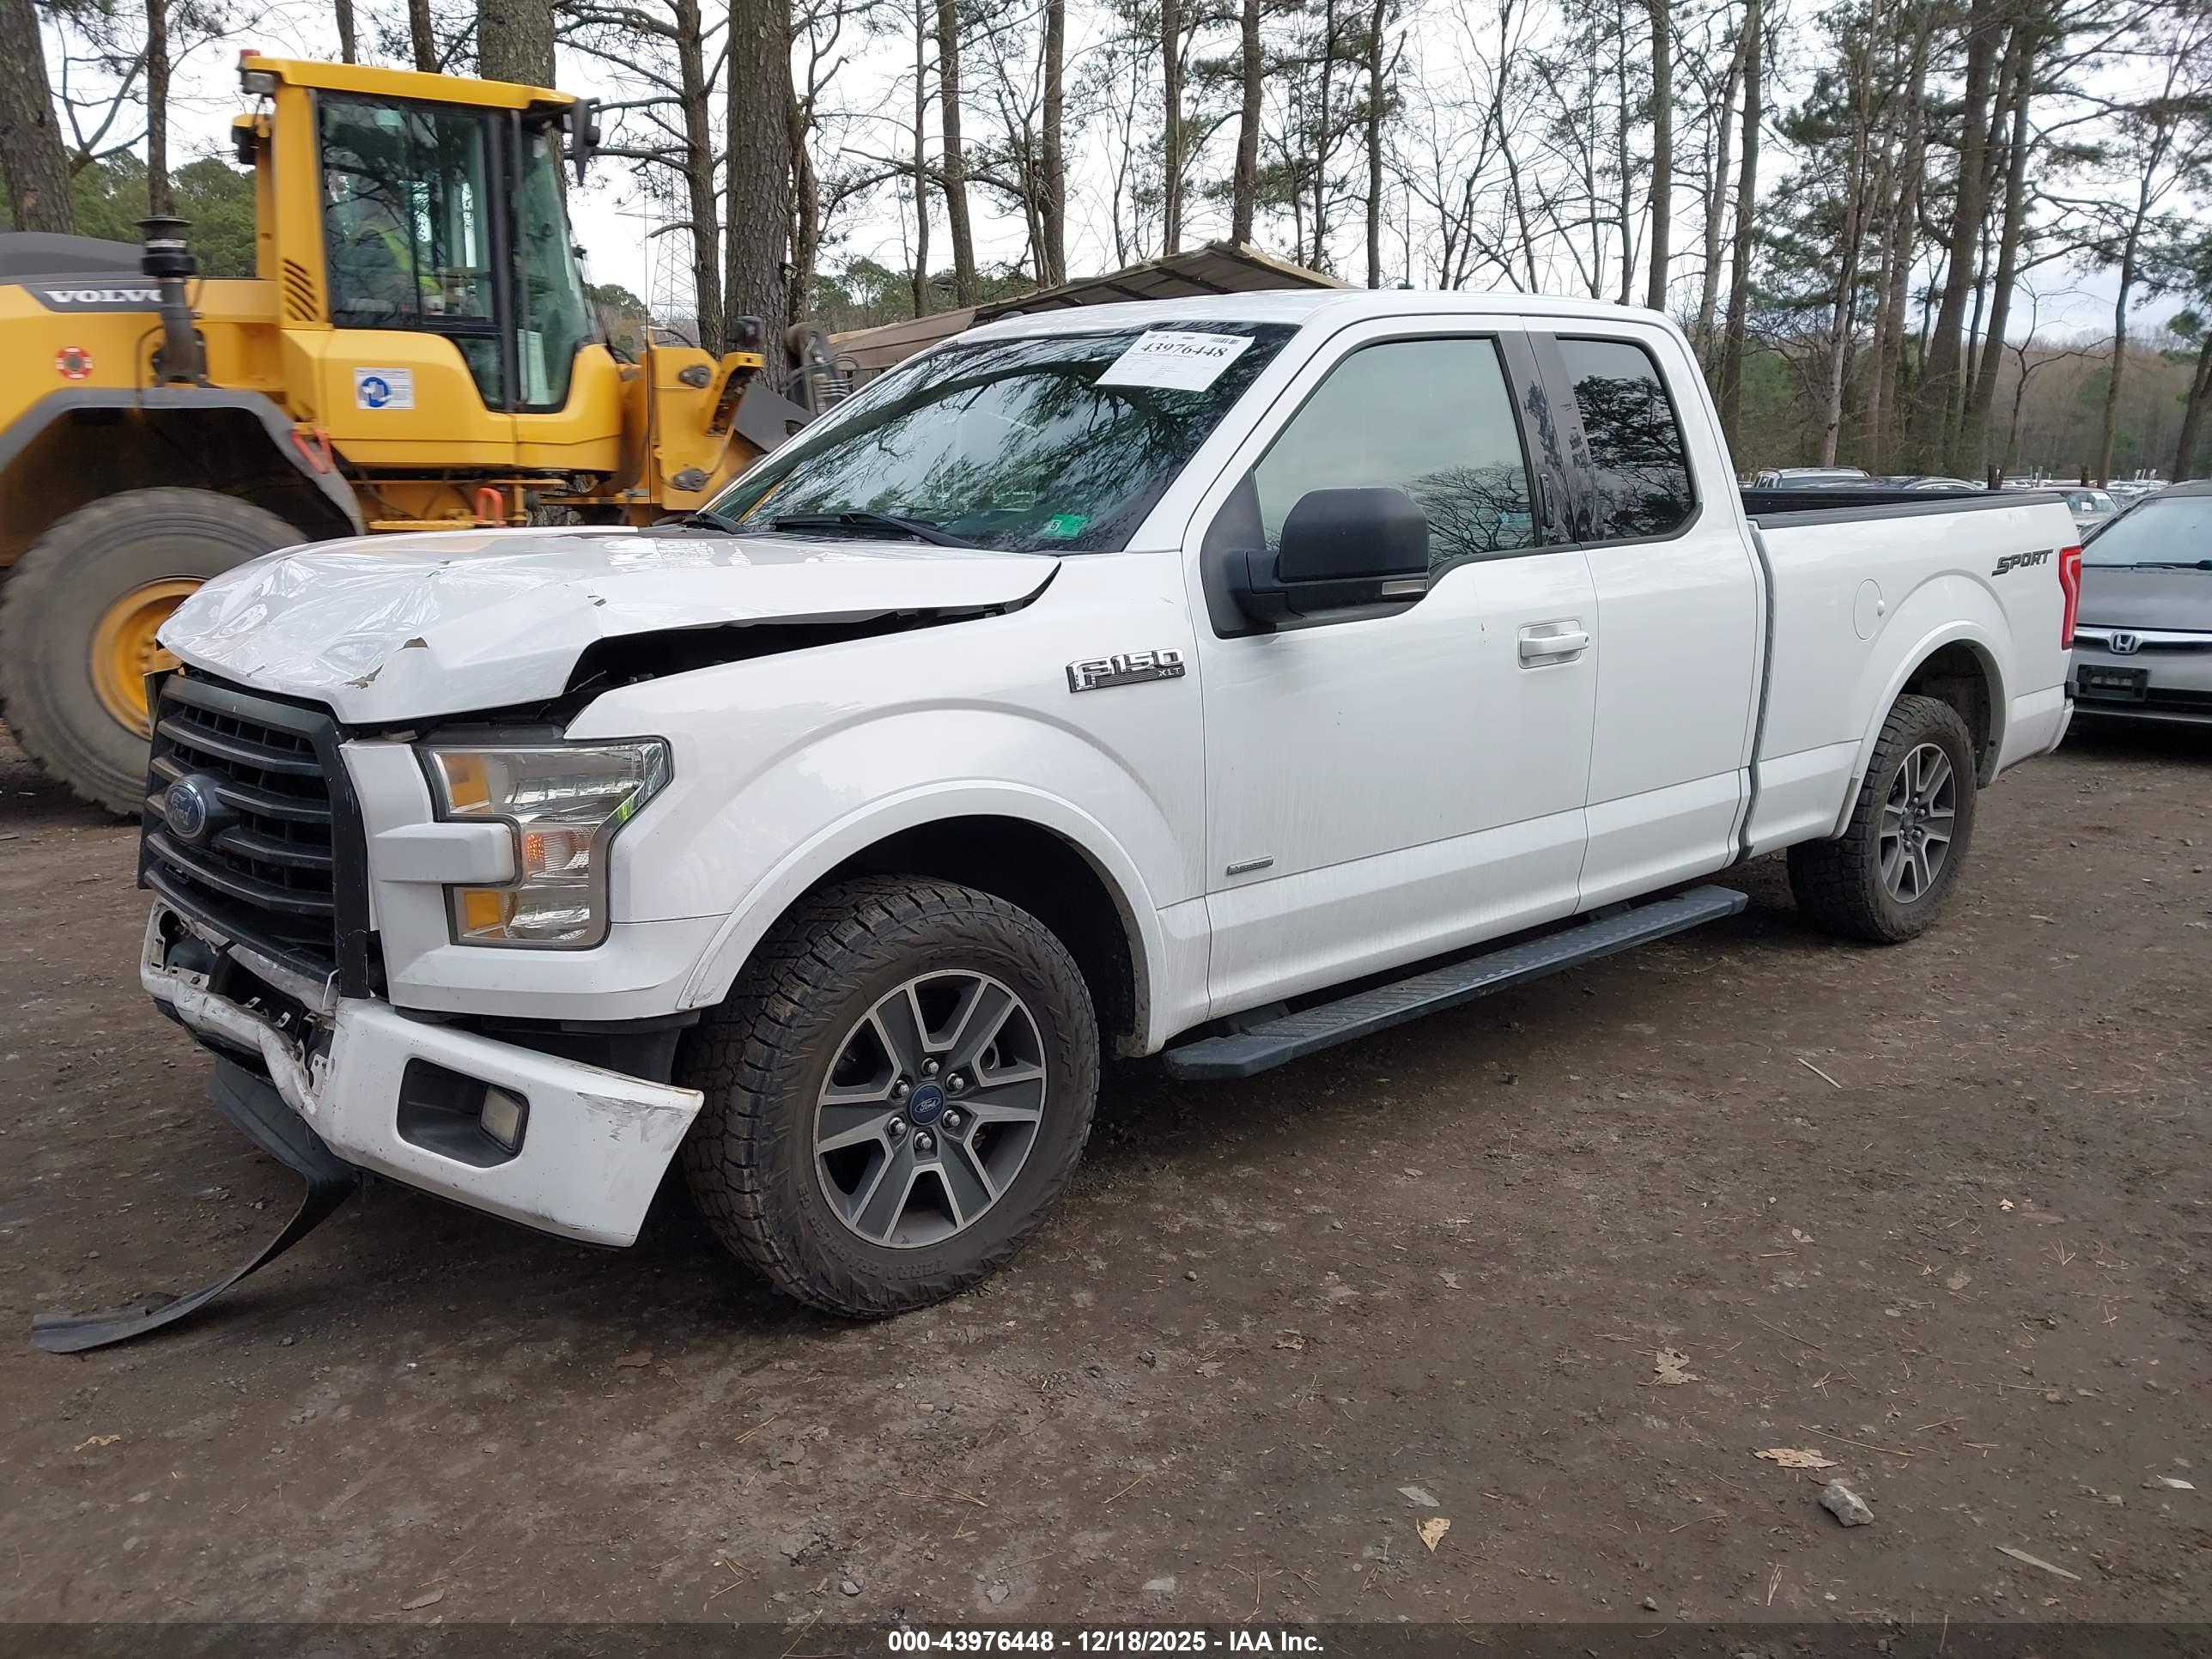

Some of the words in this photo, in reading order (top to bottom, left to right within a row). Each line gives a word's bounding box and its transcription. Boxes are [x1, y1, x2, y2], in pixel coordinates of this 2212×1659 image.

[1140, 343, 1229, 357] 43976448
[1991, 549, 2054, 577] SPORT
[1158, 667, 1182, 677] XLT
[171, 792, 191, 826] Ford
